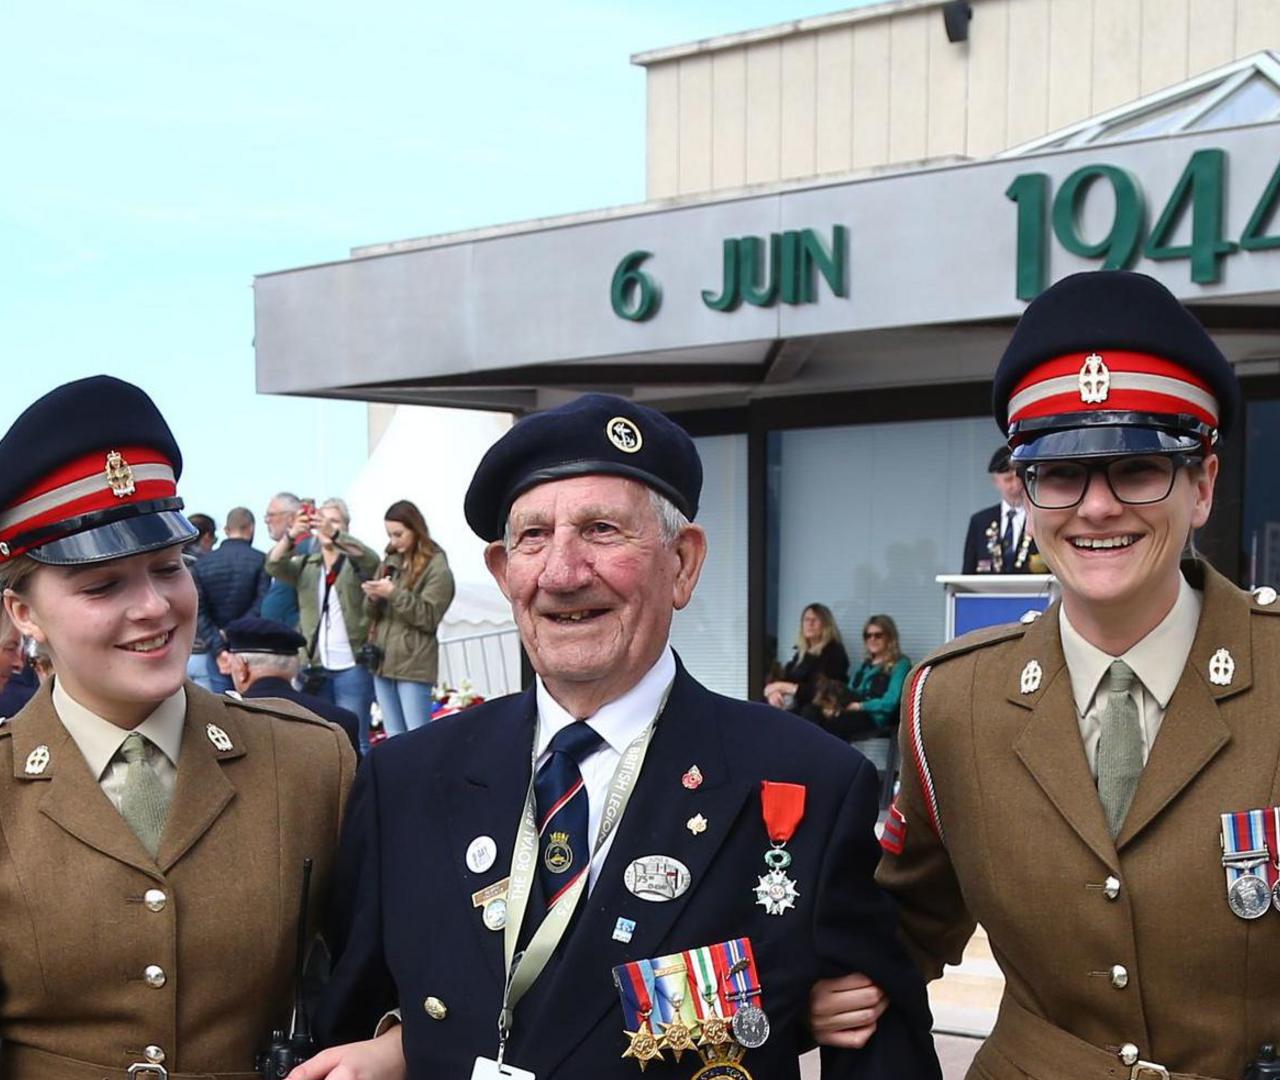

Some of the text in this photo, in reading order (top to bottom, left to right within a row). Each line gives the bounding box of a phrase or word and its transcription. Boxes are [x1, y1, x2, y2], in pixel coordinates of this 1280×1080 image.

[611, 251, 660, 322] 6
[702, 225, 848, 312] JUIN
[615, 745, 641, 792] BRITISH
[598, 792, 623, 843] LEGION
[516, 830, 536, 872] ROYAL
[512, 874, 527, 901] THE
